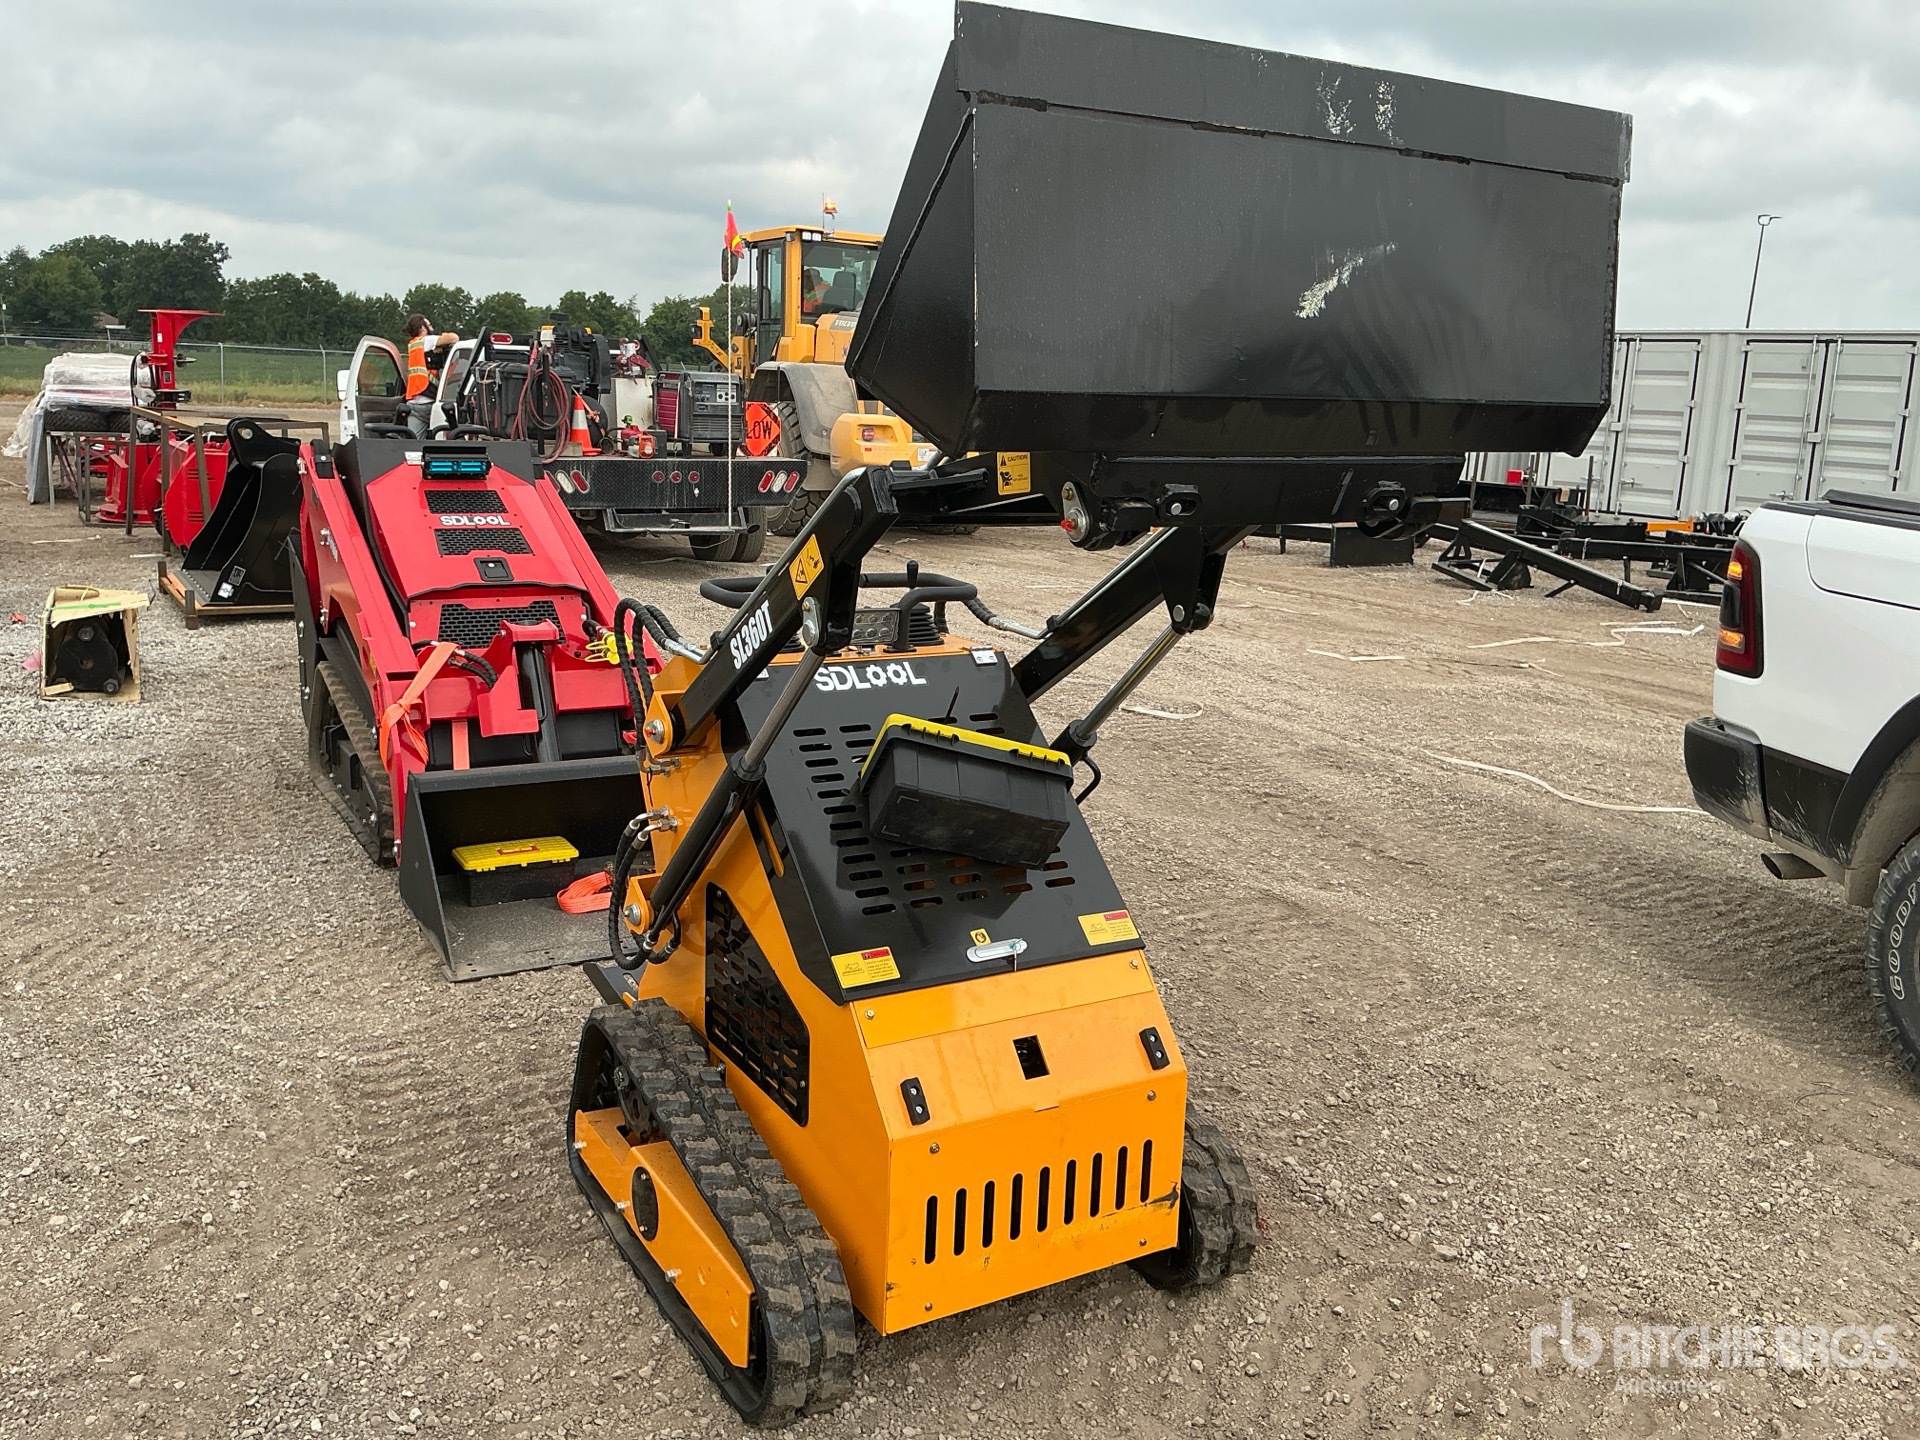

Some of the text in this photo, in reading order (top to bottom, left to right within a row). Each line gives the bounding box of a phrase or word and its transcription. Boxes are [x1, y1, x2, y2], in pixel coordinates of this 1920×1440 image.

[1007, 454, 1028, 462] CAUTION
[439, 515, 511, 526] SDLOOL
[730, 599, 773, 670] SL360T
[813, 661, 928, 691] SDLOOL
